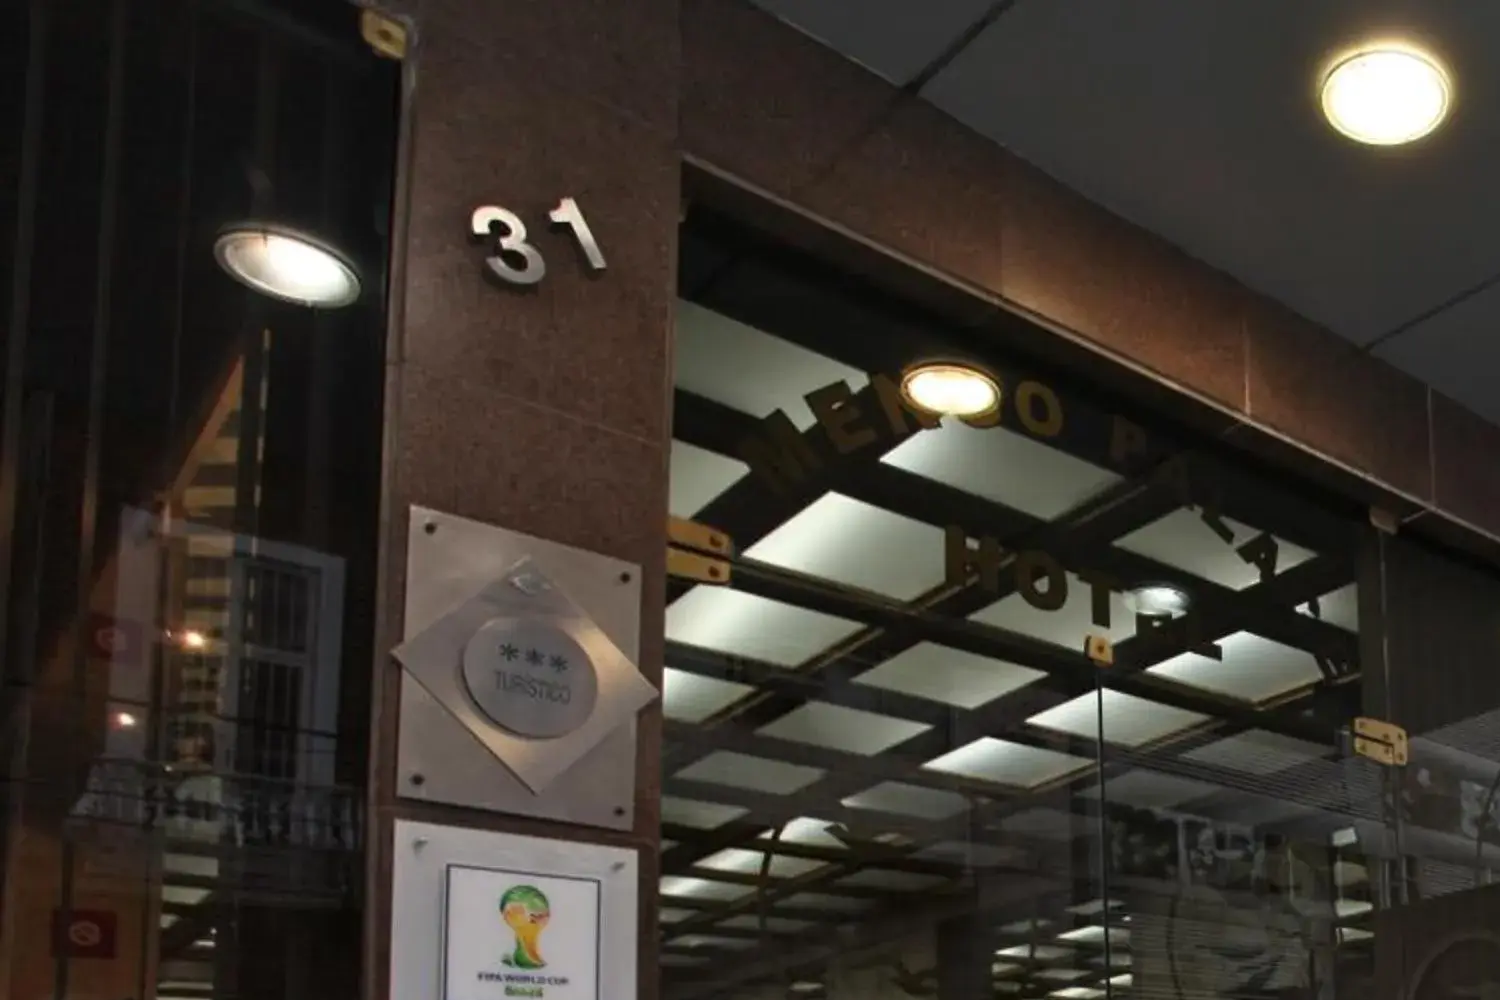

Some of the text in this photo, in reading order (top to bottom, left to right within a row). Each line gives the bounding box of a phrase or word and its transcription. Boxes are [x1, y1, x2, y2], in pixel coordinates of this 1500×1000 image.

[470, 197, 607, 285] 31
[737, 372, 1064, 496] MENO
[945, 525, 1223, 661] HOTEL
